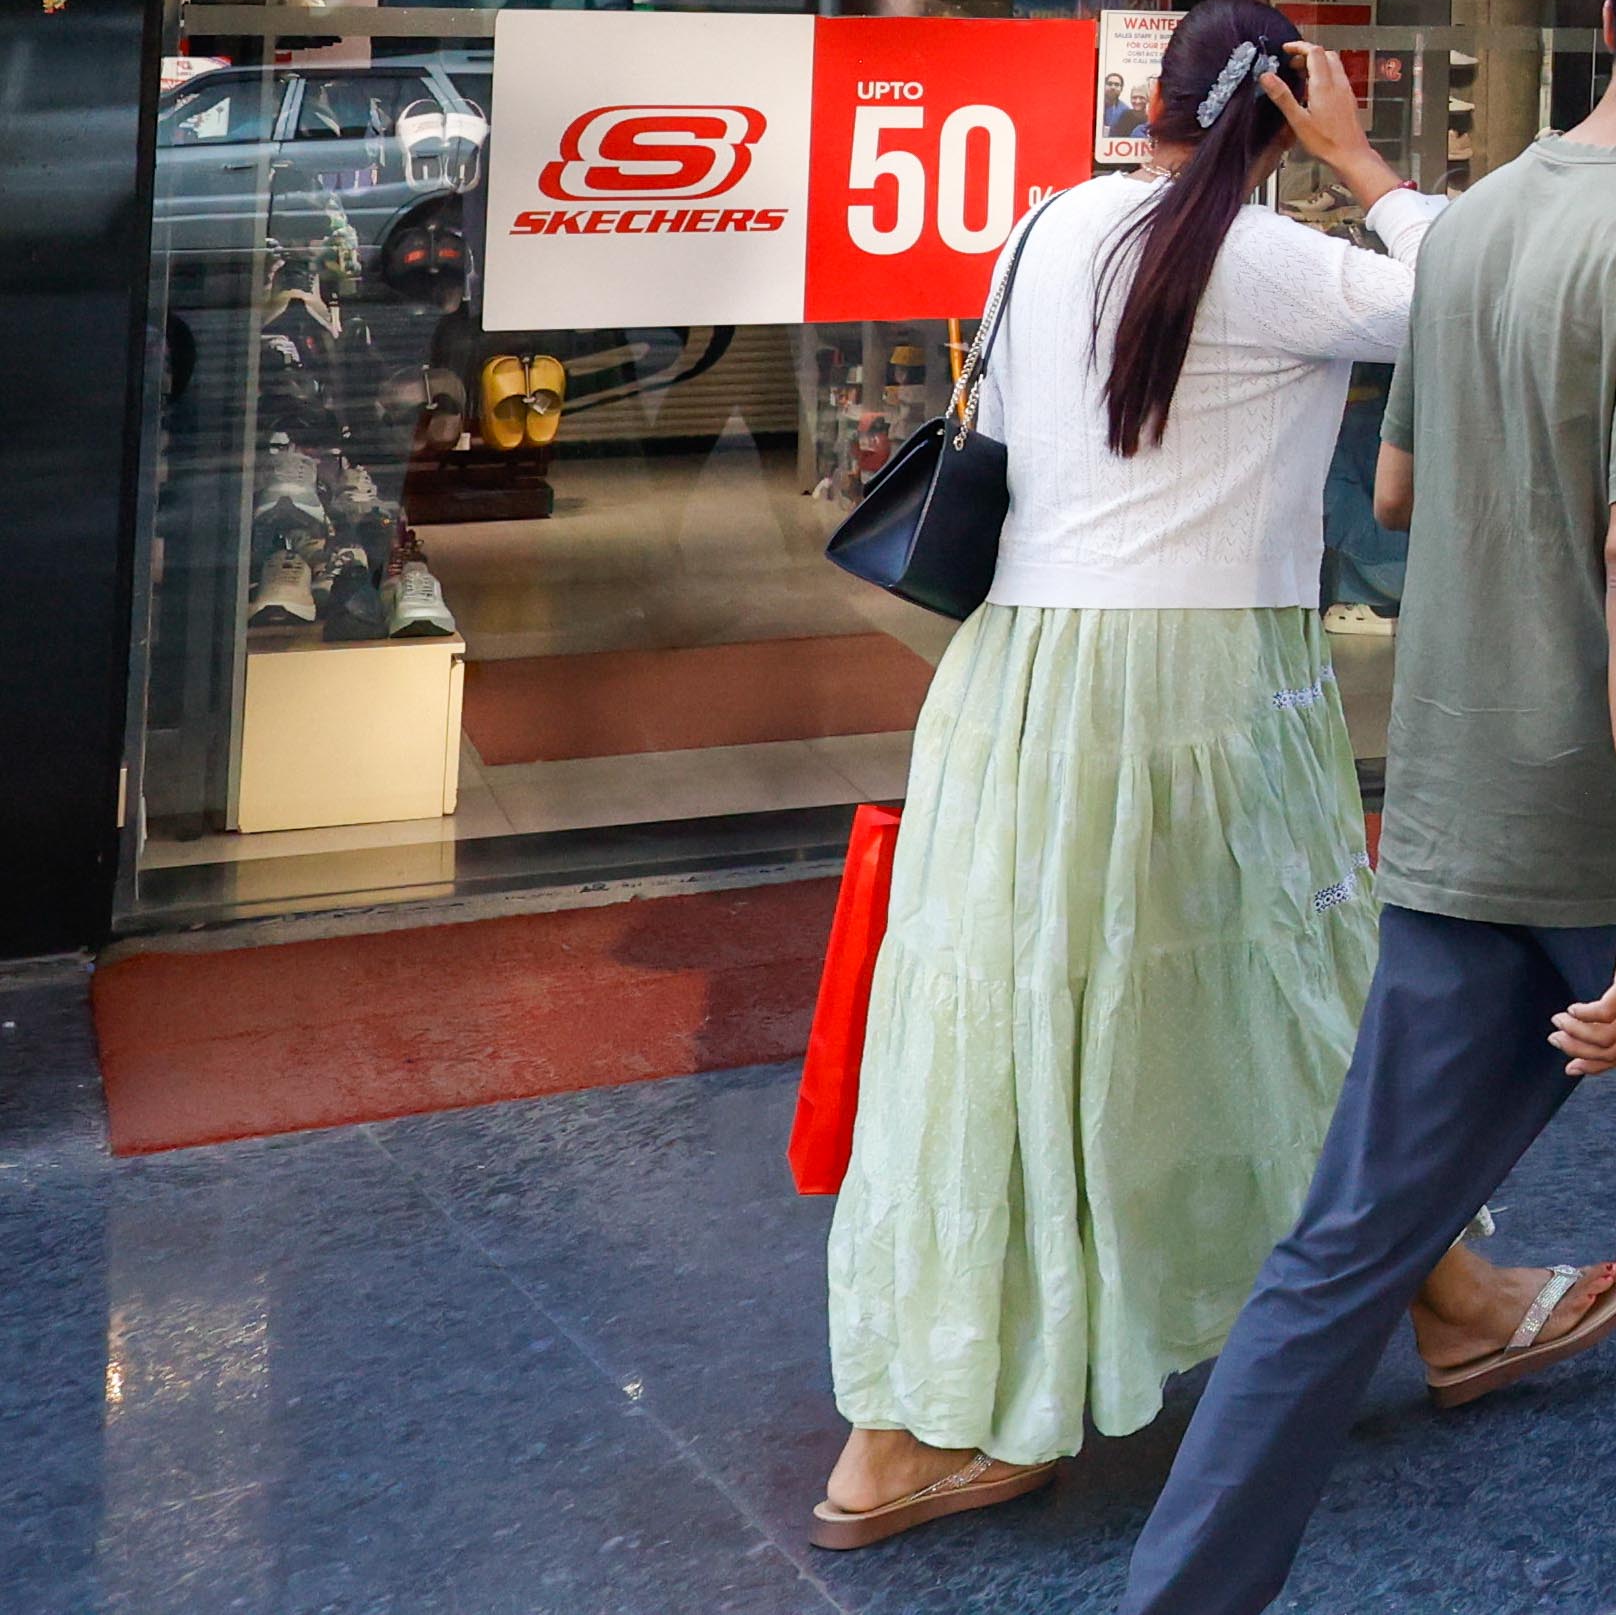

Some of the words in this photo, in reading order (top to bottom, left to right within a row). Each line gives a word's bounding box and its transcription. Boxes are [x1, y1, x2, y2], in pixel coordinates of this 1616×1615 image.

[857, 81, 923, 100] UPTO
[847, 104, 1016, 255] 50
[509, 208, 788, 235] SKECHERS
